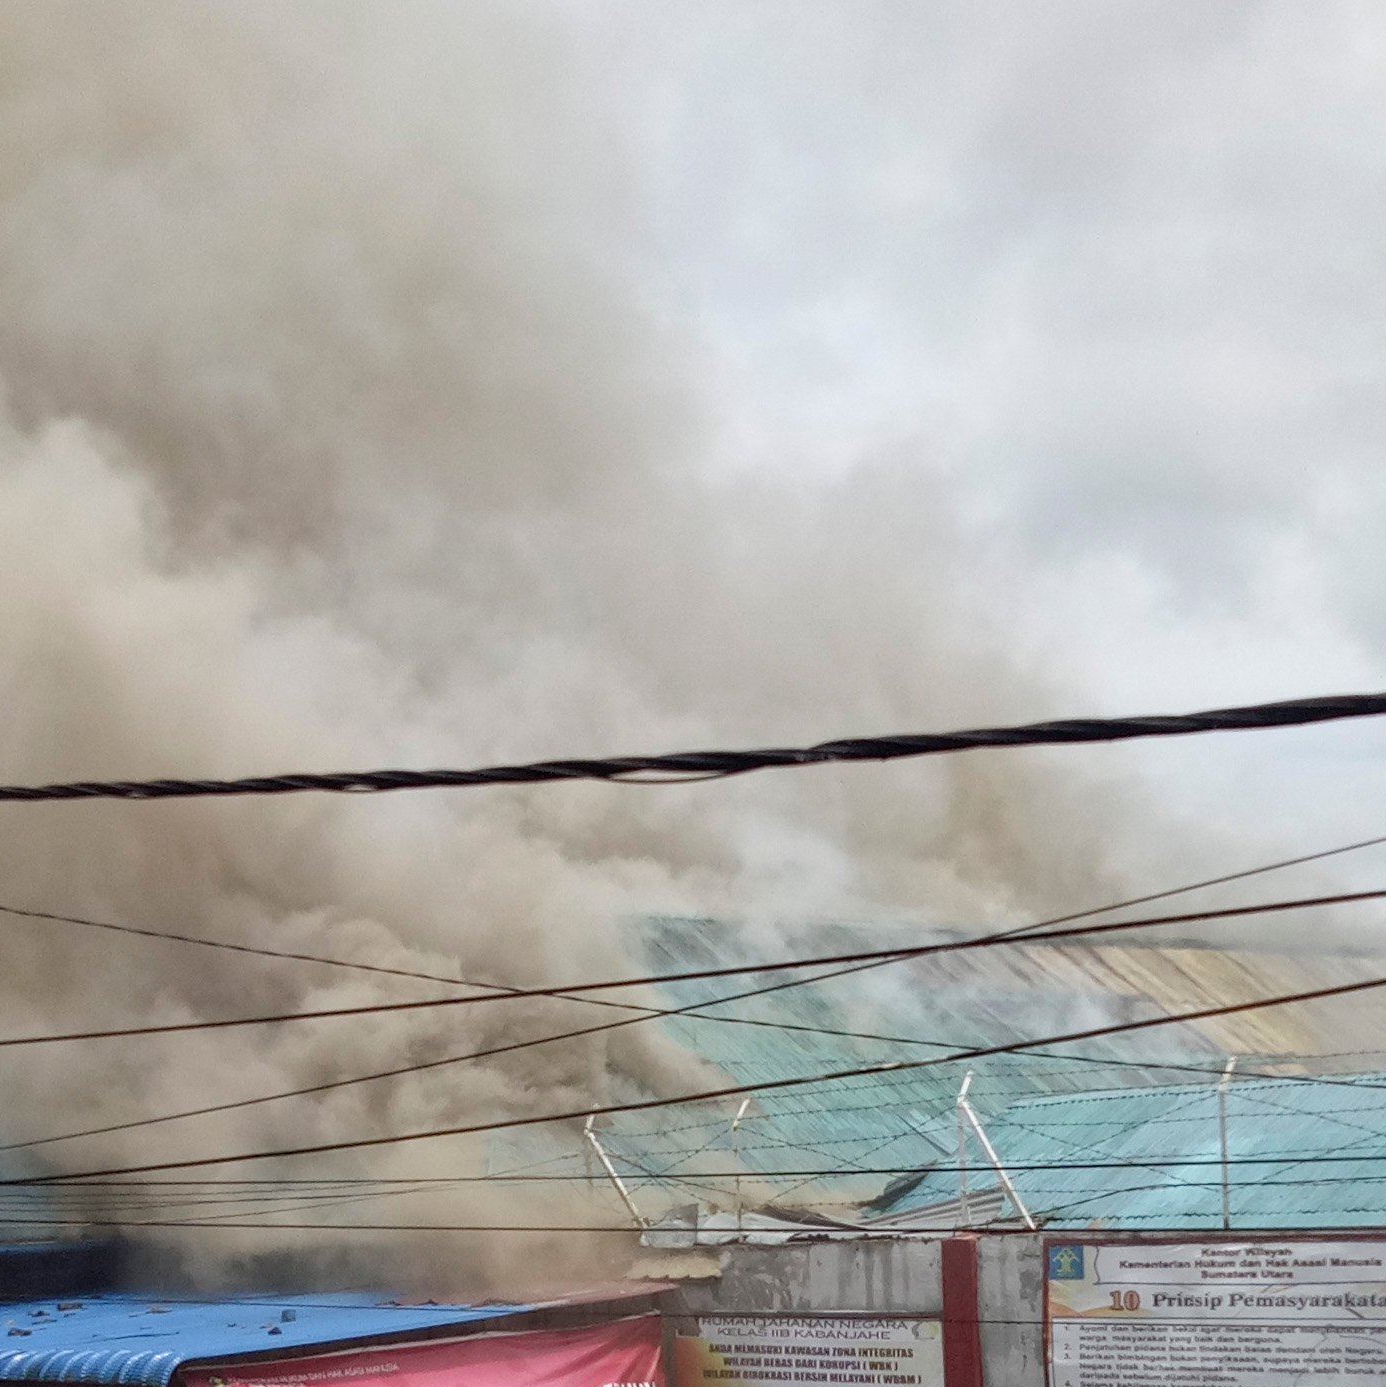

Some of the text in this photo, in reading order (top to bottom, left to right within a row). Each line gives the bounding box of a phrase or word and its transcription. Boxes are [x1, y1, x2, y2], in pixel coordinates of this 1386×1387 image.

[1119, 1260, 1191, 1269] Kementerian
[1195, 1259, 1234, 1268] Hukum
[1239, 1259, 1260, 1268] dan
[1266, 1259, 1288, 1267] Hak
[1331, 1258, 1382, 1267] Manusia
[1109, 1290, 1141, 1312] 10
[1152, 1292, 1222, 1311] Prinsip
[762, 1319, 837, 1329] TAHANAN
[839, 1320, 908, 1330] NEGARA
[717, 1328, 768, 1337] KELAS
[785, 1346, 830, 1356] KAWASAN
[859, 1348, 914, 1358] INTEGRITAS
